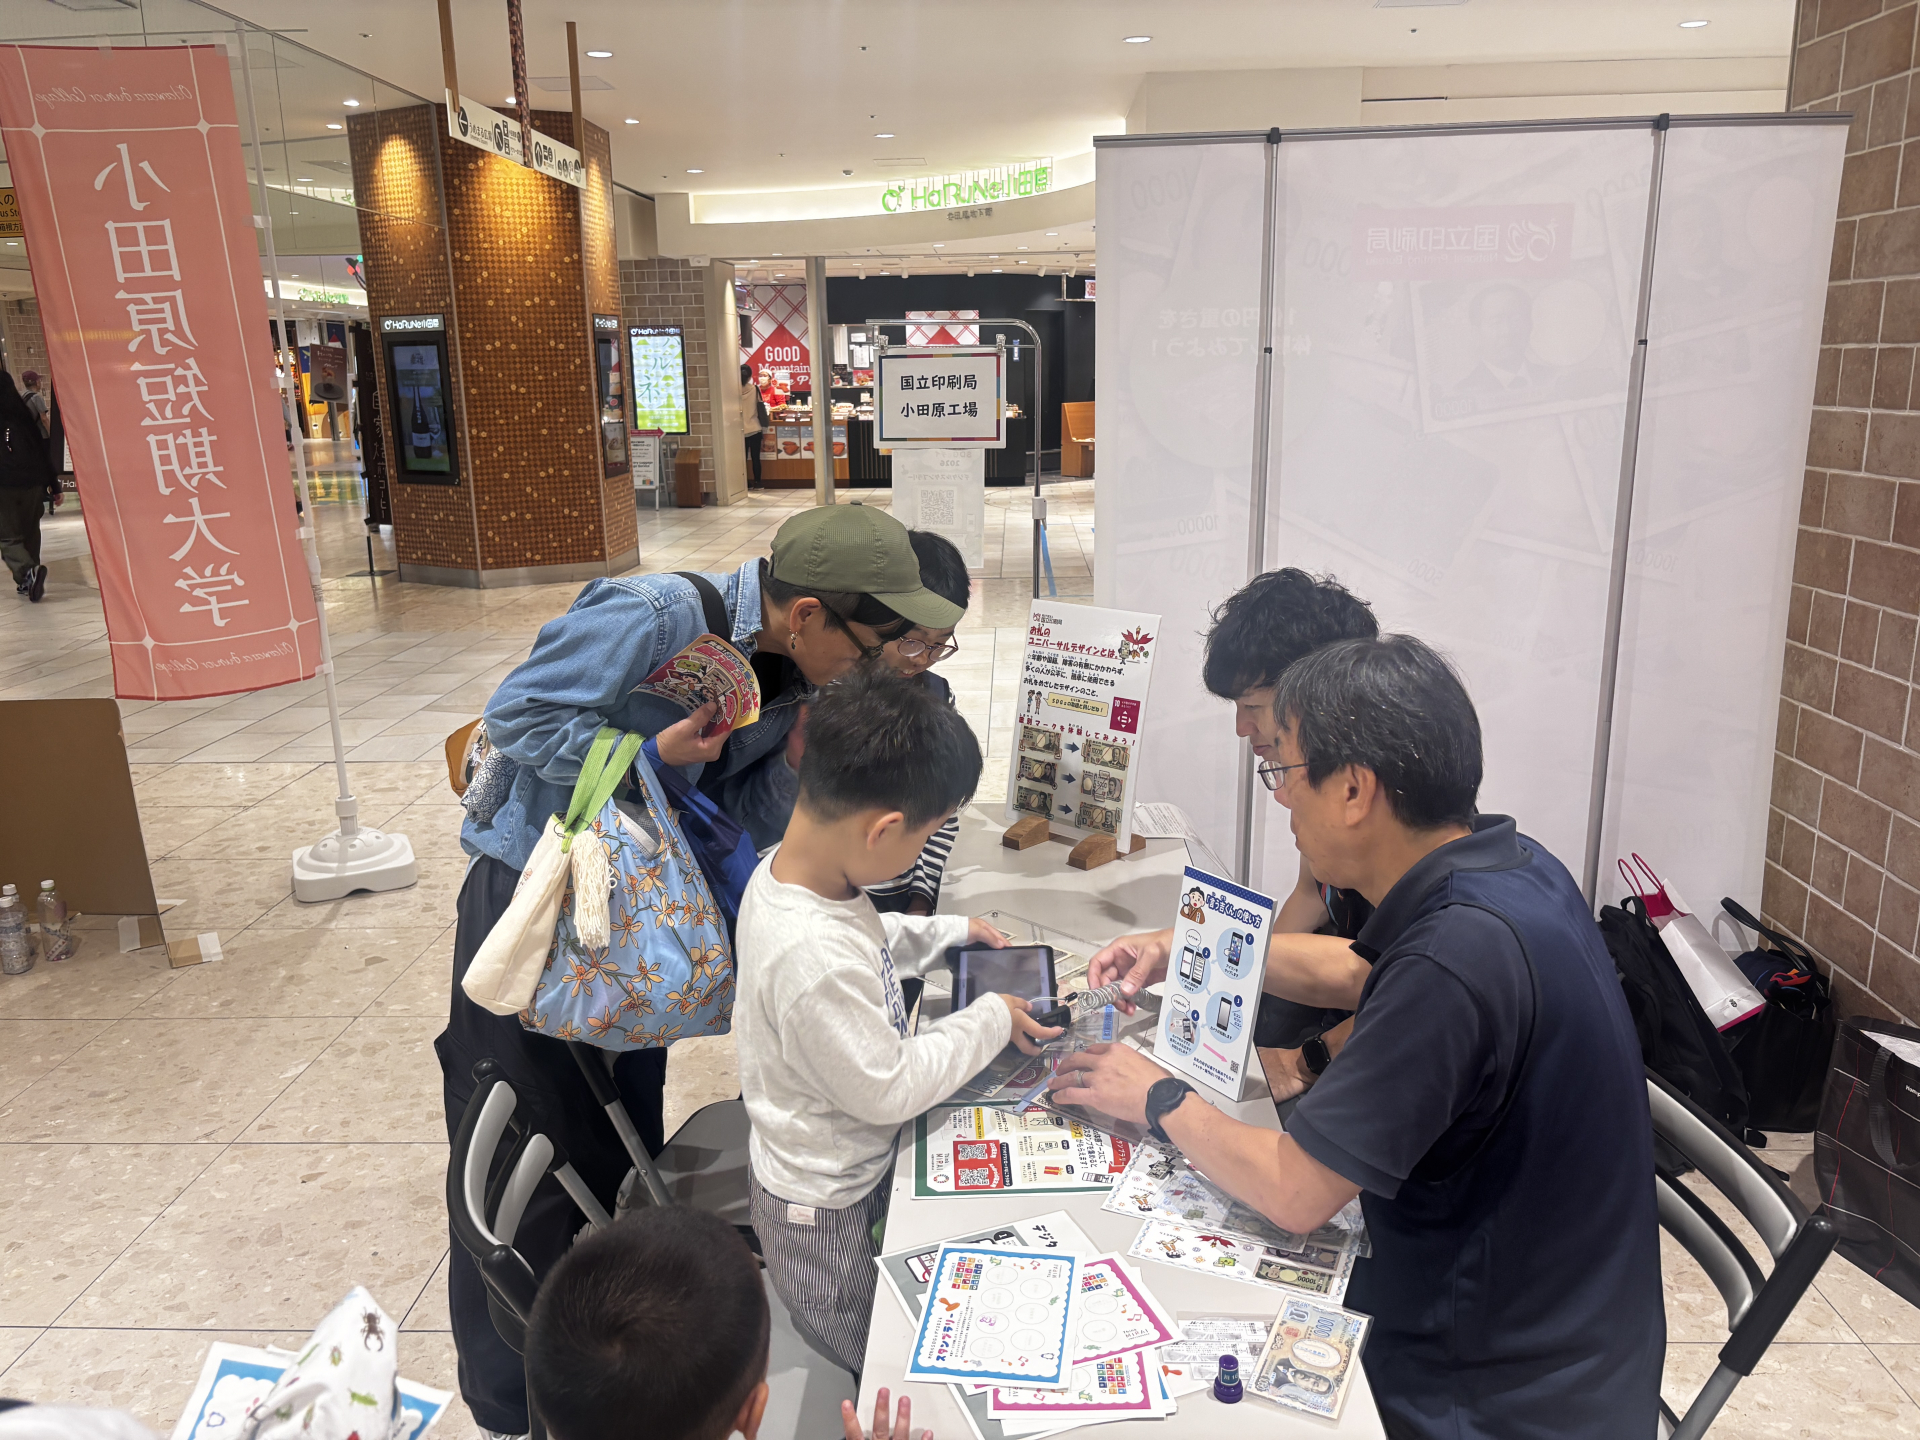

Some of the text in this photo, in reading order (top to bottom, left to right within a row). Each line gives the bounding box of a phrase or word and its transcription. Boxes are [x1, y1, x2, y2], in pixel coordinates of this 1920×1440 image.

[765, 346, 800, 362] GOOD
[900, 374, 978, 391] 国立印刷局
[900, 401, 978, 418] 小田原工場
[1030, 625, 1051, 637] お札の
[1297, 1274, 1317, 1284] 10000
[936, 1313, 955, 1361] スタンプラリー
[1125, 1328, 1149, 1339] MIRAI
